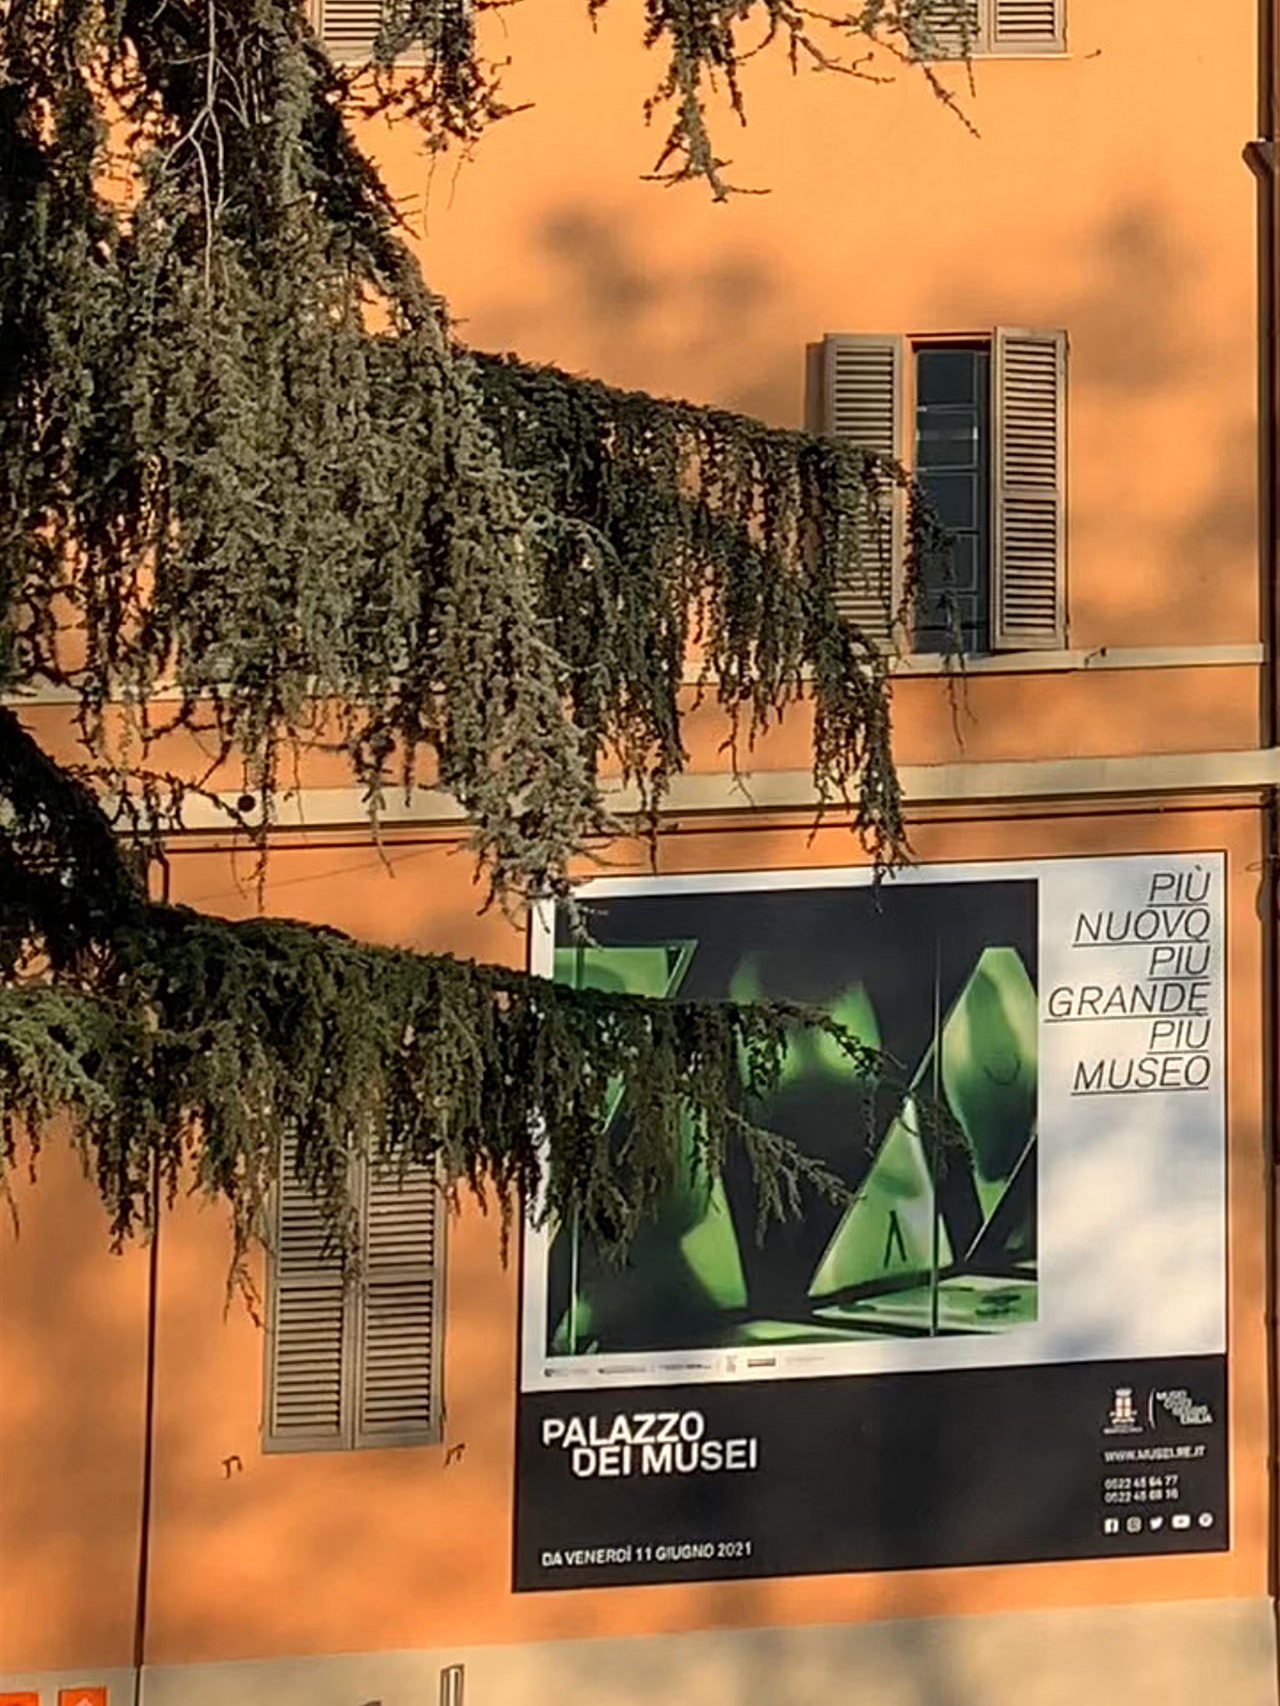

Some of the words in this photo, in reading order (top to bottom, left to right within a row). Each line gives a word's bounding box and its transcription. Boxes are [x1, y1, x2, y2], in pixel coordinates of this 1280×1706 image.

[1149, 864, 1211, 902] PIÙ
[1074, 908, 1210, 942] NUOVO
[1047, 982, 1212, 1018] GRANDE
[1073, 1055, 1210, 1091] MUSEO
[542, 1411, 705, 1448] PALAZZO
[572, 1445, 631, 1477] DEI
[642, 1438, 757, 1474] MUSEI
[541, 1552, 563, 1567] DA
[635, 1547, 651, 1561] 11
[655, 1543, 714, 1562] GIUGNO
[717, 1540, 752, 1558] 2021
